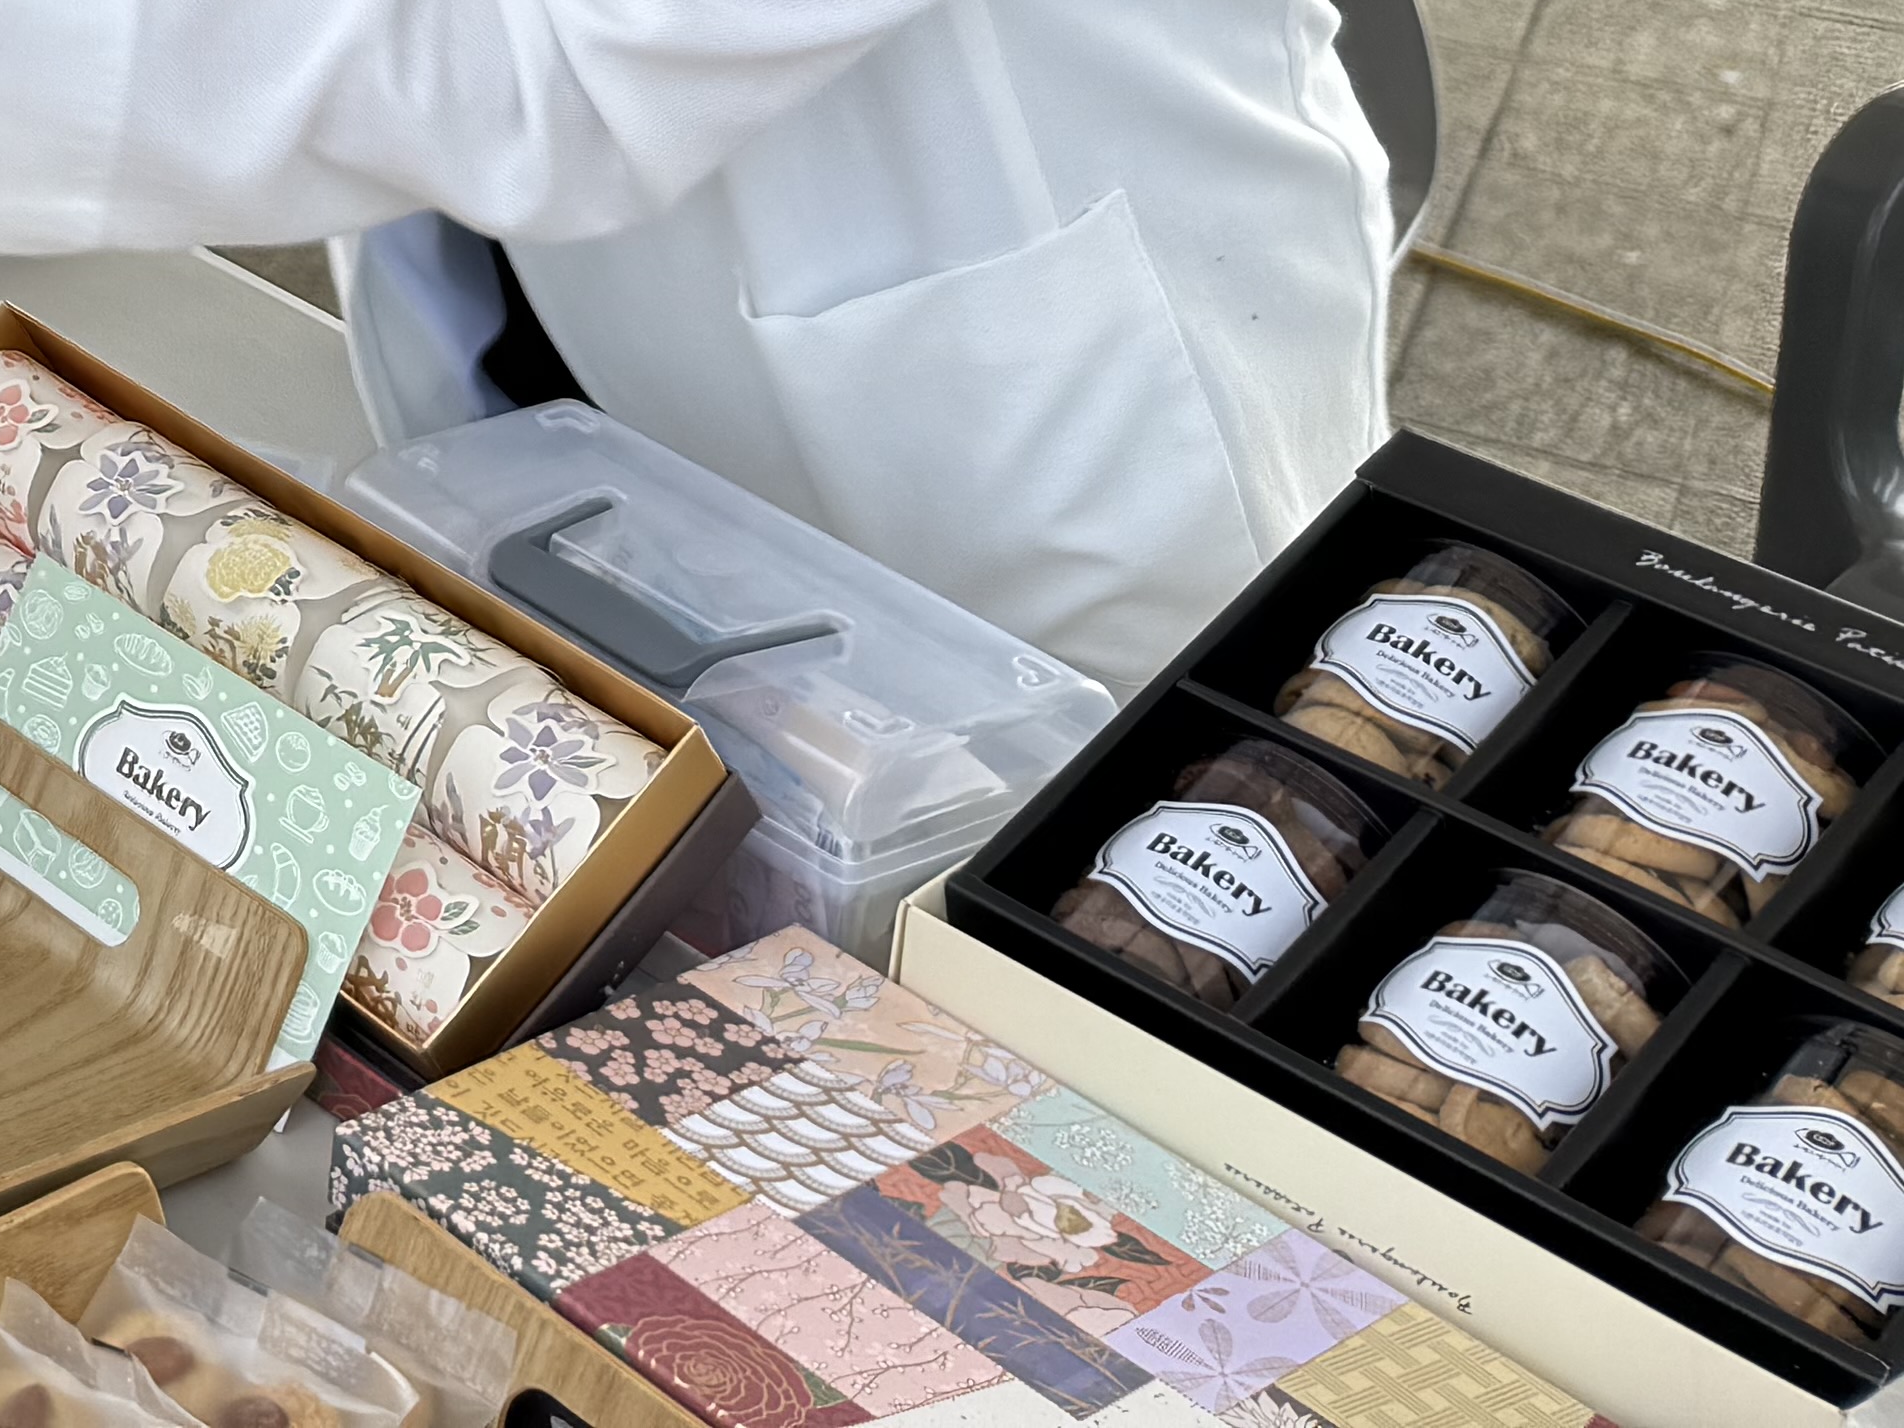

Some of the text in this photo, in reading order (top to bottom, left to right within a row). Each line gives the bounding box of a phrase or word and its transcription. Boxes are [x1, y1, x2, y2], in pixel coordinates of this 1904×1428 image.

[1365, 622, 1492, 702] Bakery
[115, 745, 212, 832] Bakery
[1626, 740, 1767, 815] Bakery
[1145, 831, 1273, 918] Bakery
[1420, 969, 1558, 1058] Bakery
[1724, 1141, 1884, 1234] Bakery
